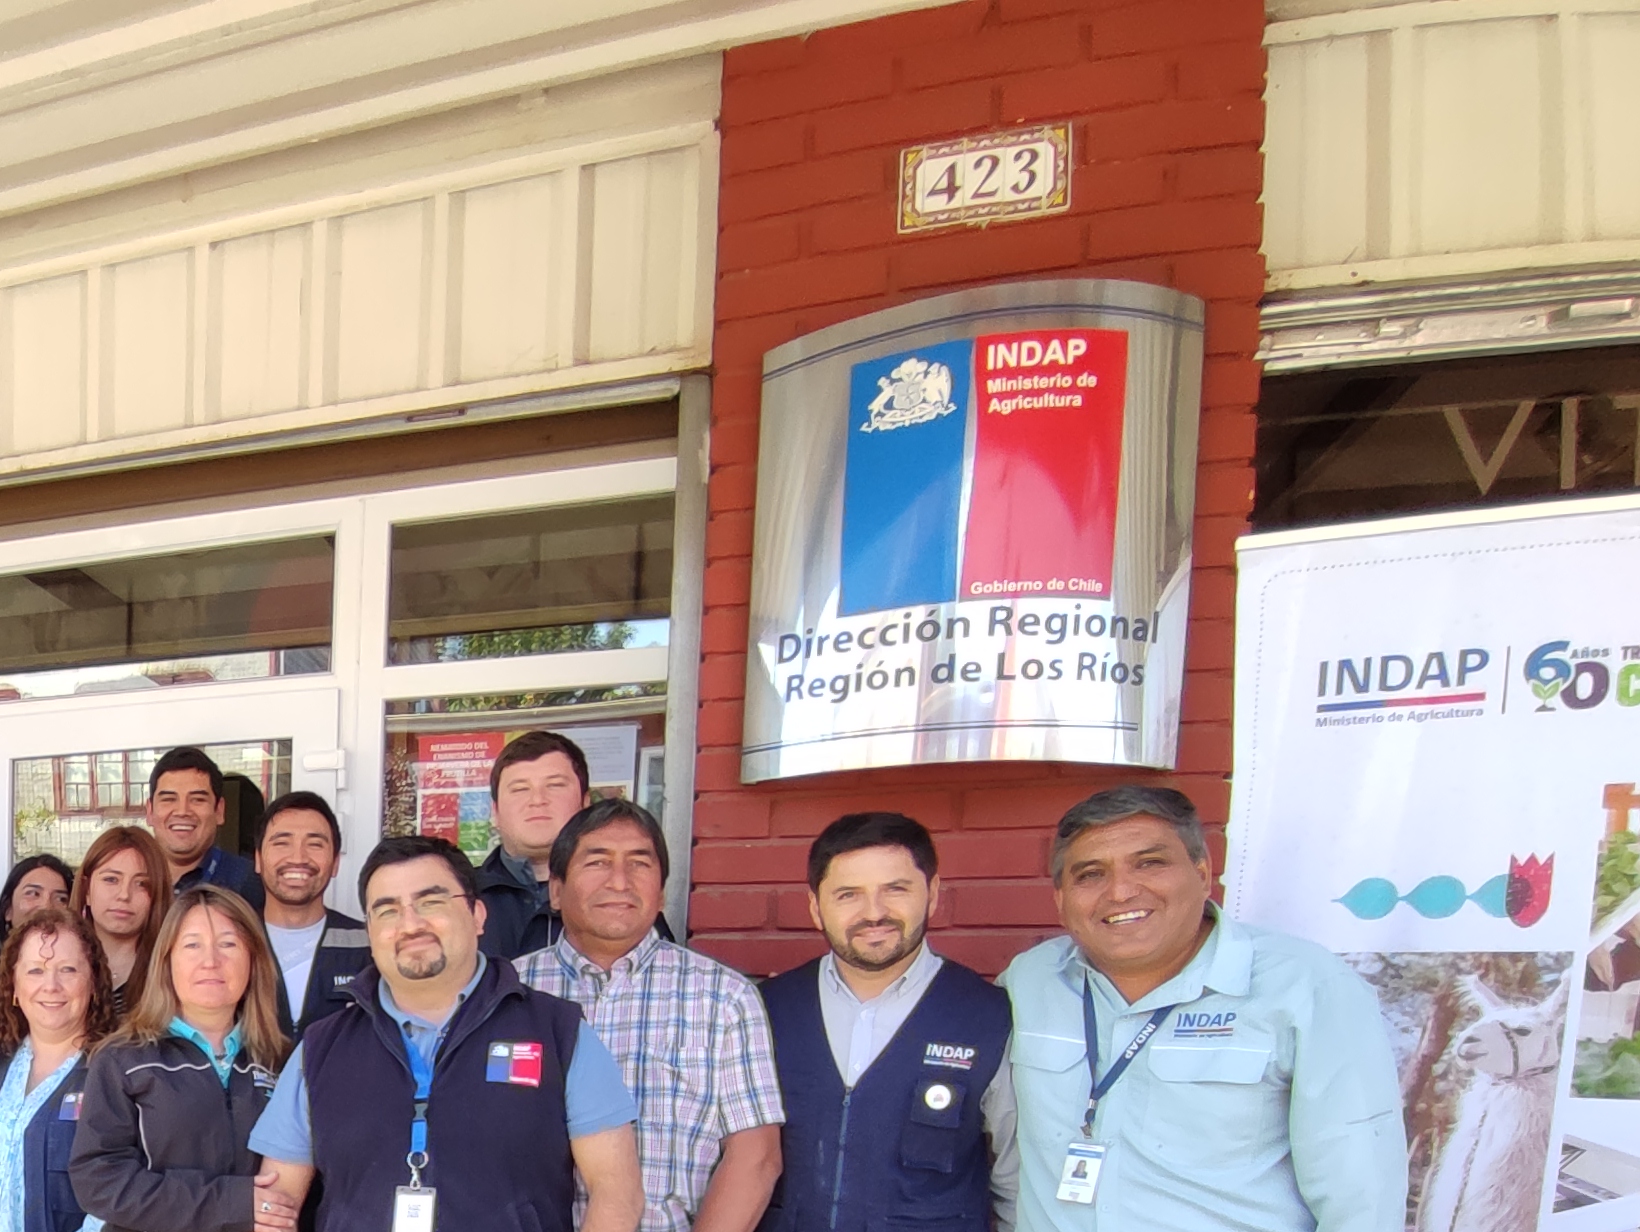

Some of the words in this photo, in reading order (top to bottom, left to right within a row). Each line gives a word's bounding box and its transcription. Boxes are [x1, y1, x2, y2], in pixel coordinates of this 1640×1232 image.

[926, 148, 1039, 205] 423
[987, 338, 1087, 370] INDAP
[987, 373, 1073, 394] Ministerio
[1076, 372, 1098, 388] de
[988, 392, 1082, 415] Agricultura
[970, 579, 1044, 595] Gobierno
[1047, 577, 1065, 591] de
[1068, 578, 1103, 592] Chile
[777, 608, 971, 664] Dirección
[988, 603, 1160, 645] Regional
[785, 660, 917, 703] Región
[931, 653, 982, 684] de
[997, 652, 1063, 681] Los
[1077, 651, 1145, 686] Ríos
[1317, 648, 1490, 697] INDAP
[1315, 713, 1384, 727] Ministerio
[1388, 711, 1404, 722] de
[1407, 708, 1484, 723] Agricultura
[1175, 1012, 1237, 1028] INDAP
[925, 1043, 975, 1060] INDAP
[1124, 1022, 1157, 1060] INDAP
